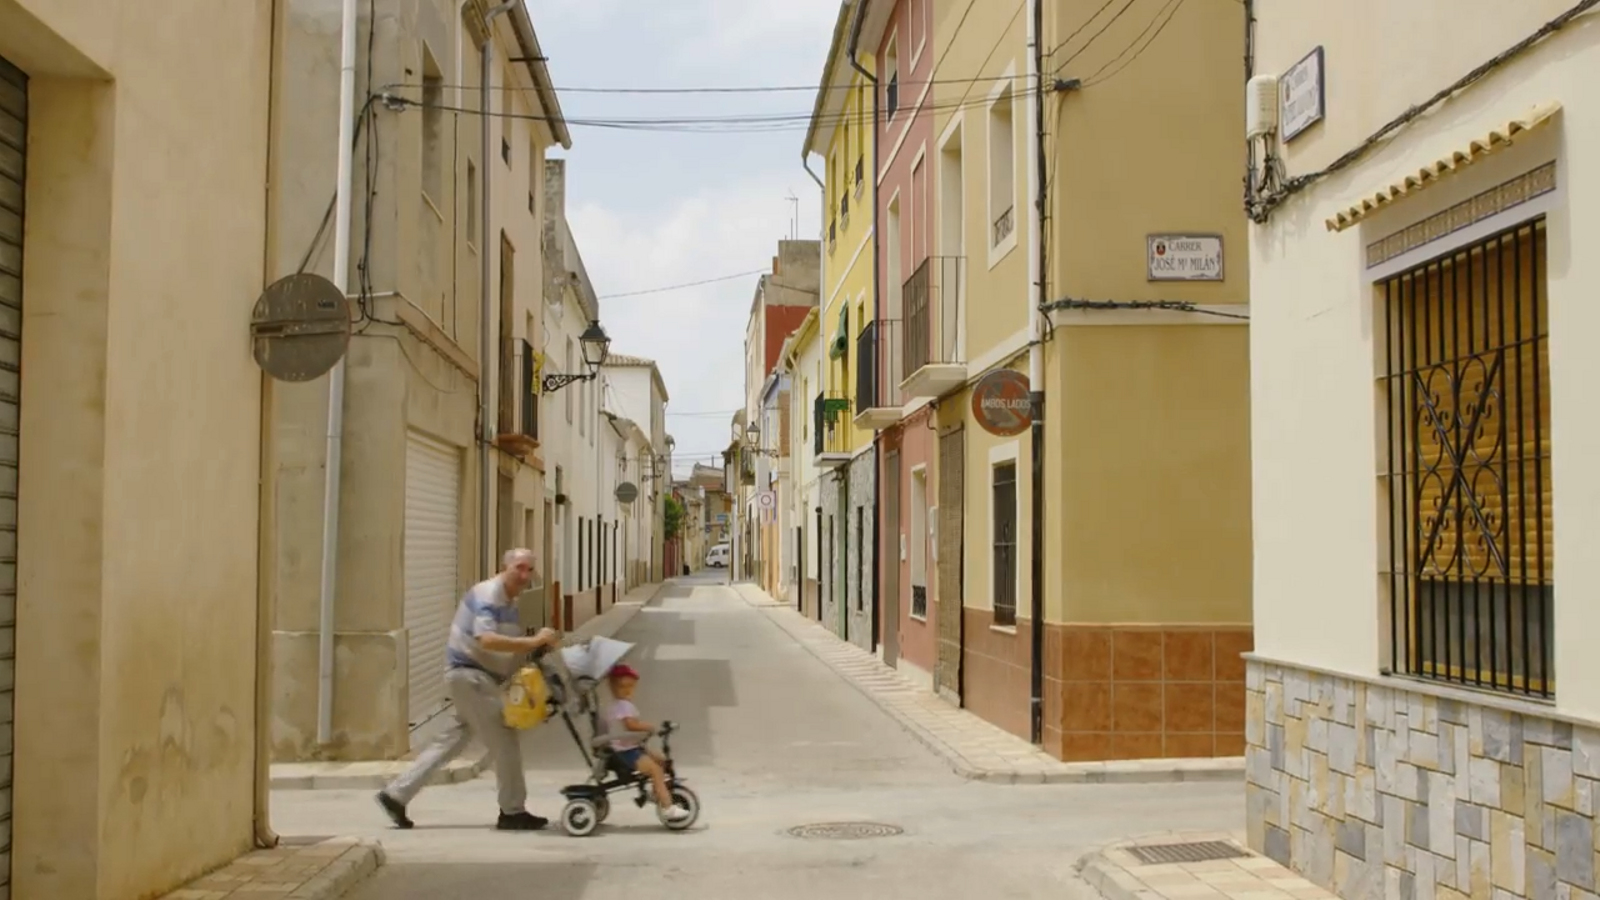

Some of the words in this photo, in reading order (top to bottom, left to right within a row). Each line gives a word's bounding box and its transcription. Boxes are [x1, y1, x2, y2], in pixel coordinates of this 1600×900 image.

[1168, 241, 1202, 251] CARRER
[980, 397, 1006, 409] AMBOS
[1007, 398, 1031, 409] LADOS
